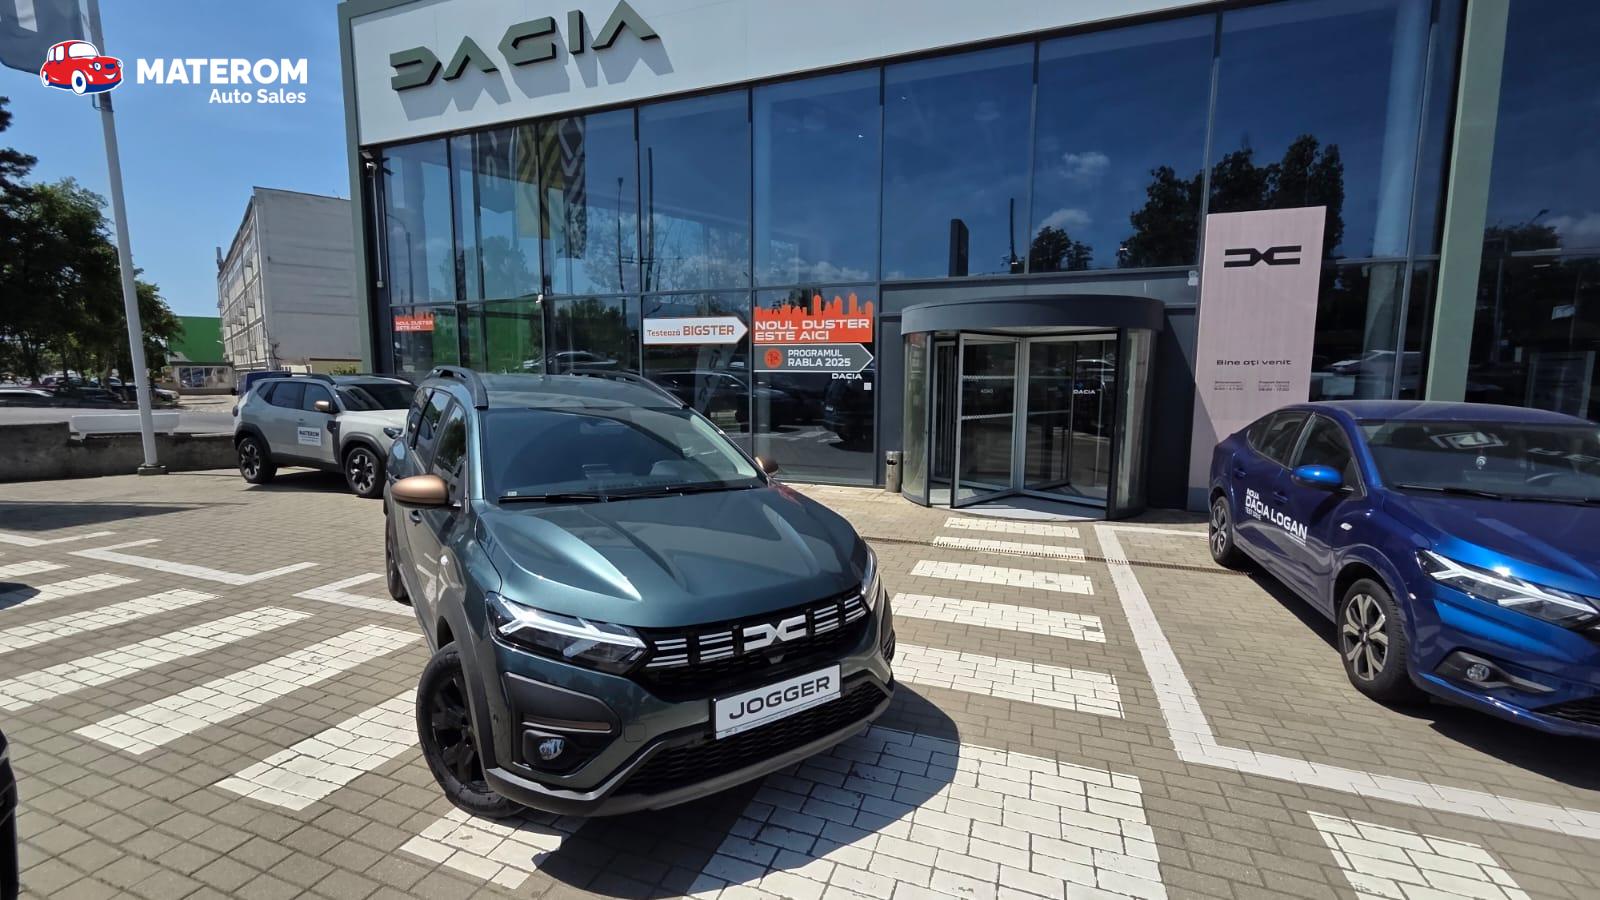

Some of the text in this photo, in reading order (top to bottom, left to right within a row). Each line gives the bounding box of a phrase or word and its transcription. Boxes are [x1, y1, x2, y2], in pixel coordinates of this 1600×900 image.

[389, 0, 661, 91] DACIA
[755, 319, 870, 330] NOUL DUSTER
[683, 325, 735, 336] BIGSTER
[755, 331, 829, 341] ESTE AICI
[788, 349, 843, 358] PROGRAMUL
[787, 358, 851, 367] RABLA 2025
[1245, 495, 1270, 519] DACIA
[1271, 508, 1308, 540] LOGAN
[729, 676, 830, 720] JOGGER
